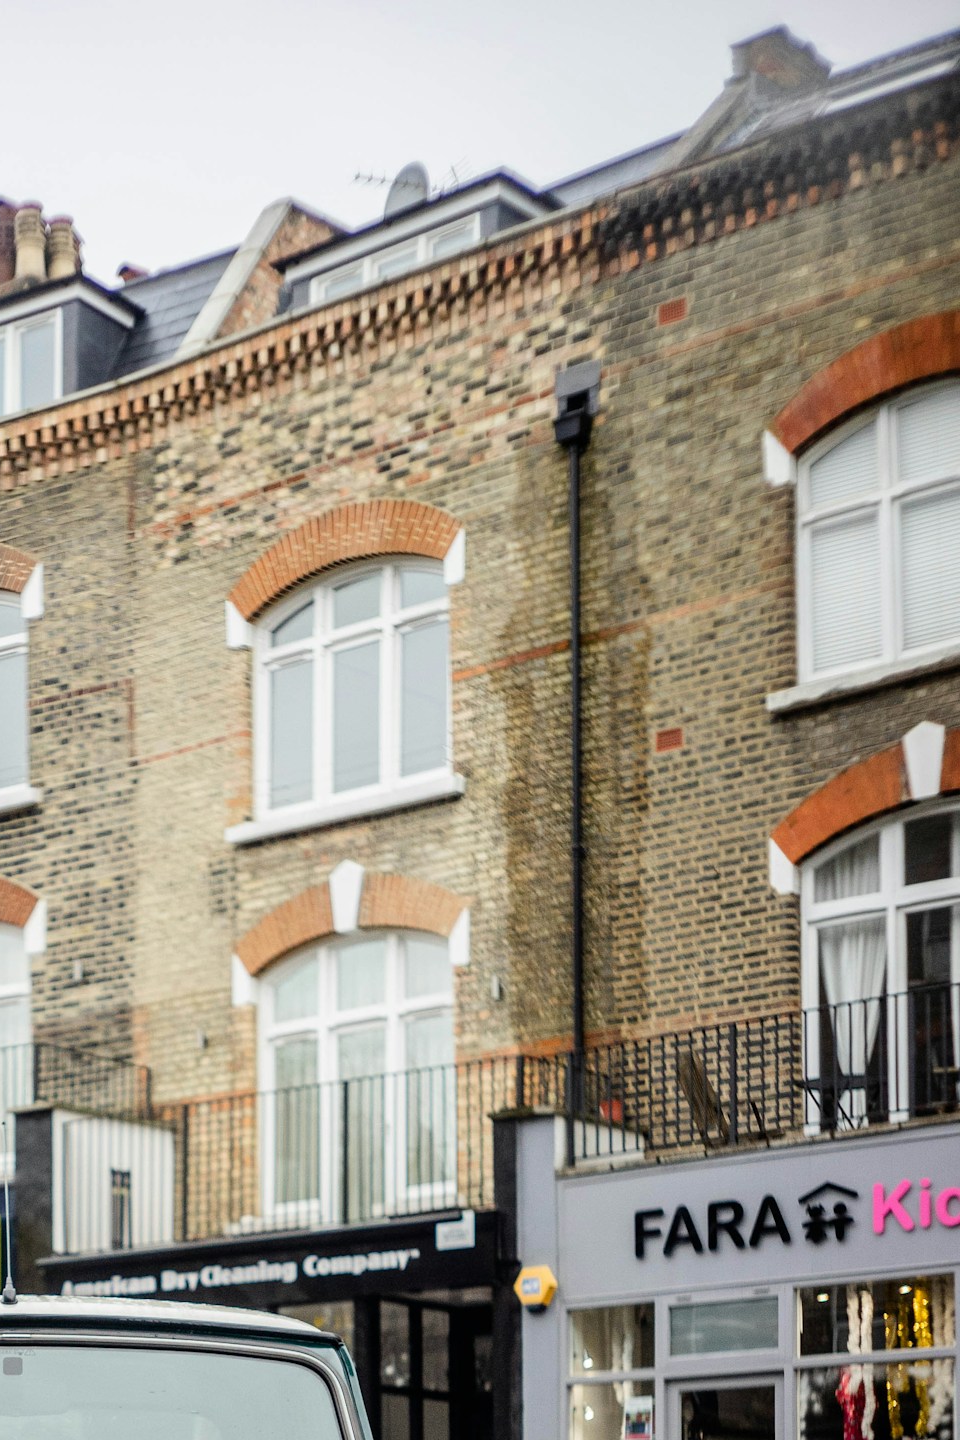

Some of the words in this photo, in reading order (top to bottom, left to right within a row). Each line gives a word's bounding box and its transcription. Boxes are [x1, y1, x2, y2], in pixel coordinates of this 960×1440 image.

[634, 1194, 791, 1259] FARA
[61, 1275, 157, 1296] American
[160, 1270, 199, 1292] Dry
[200, 1260, 297, 1284] Cleaning
